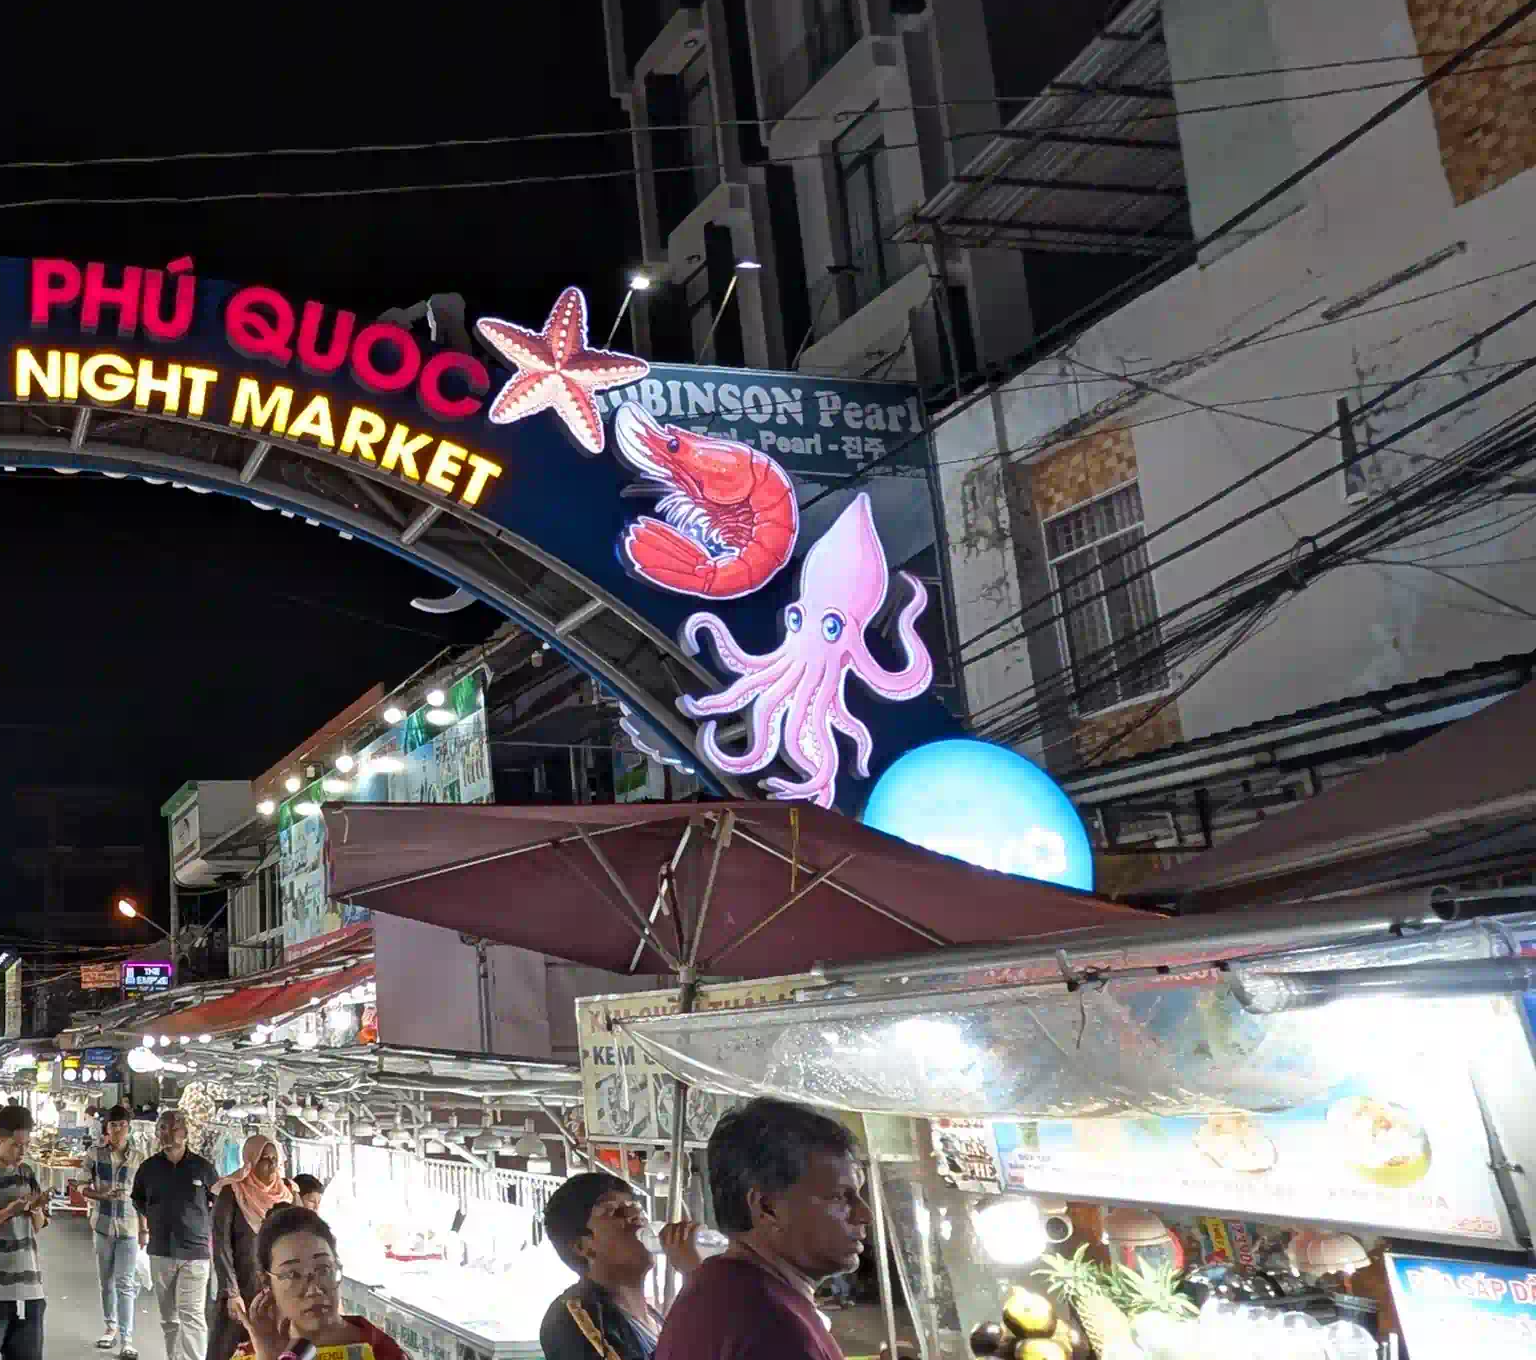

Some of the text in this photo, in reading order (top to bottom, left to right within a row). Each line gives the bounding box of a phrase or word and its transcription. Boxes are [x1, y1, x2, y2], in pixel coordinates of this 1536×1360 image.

[31, 256, 198, 342] PHÚ
[15, 347, 219, 421] NIGHT
[231, 376, 504, 509] MARKET
[598, 377, 925, 433] OBINSON Pearl
[759, 429, 822, 455] Pearl
